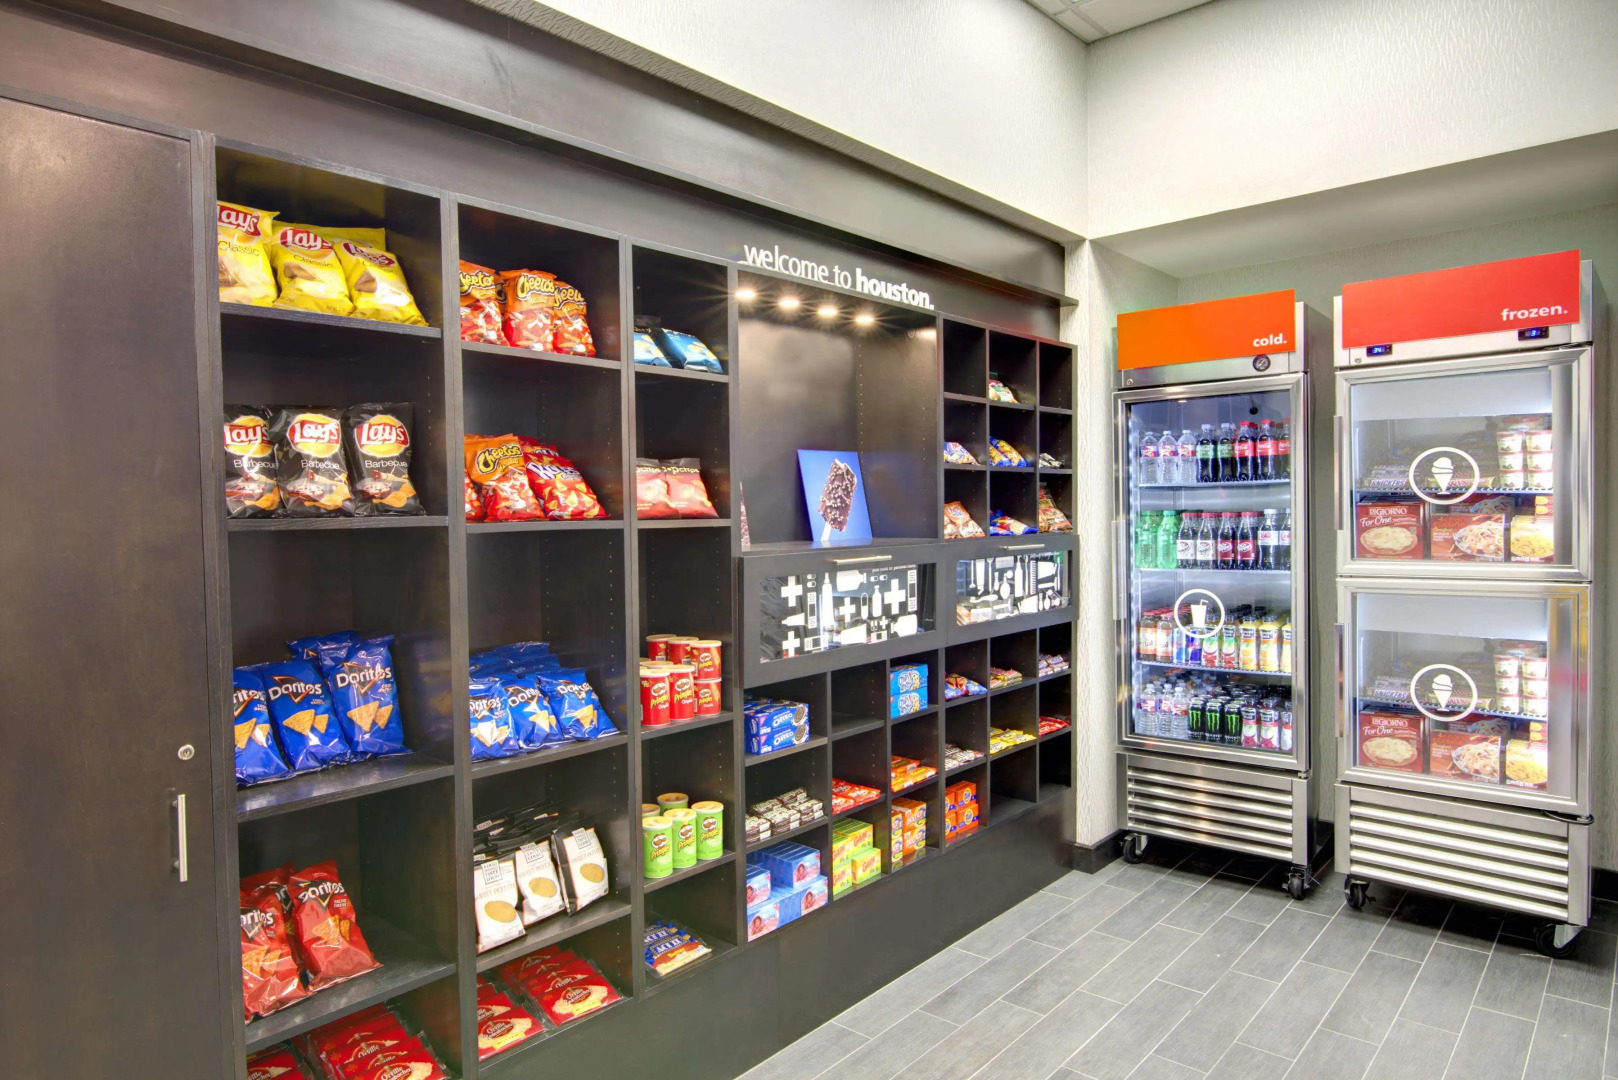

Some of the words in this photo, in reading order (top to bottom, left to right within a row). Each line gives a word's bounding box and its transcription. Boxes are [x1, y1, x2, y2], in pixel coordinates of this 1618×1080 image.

[743, 244, 829, 284] welcome
[832, 265, 852, 289] to
[856, 268, 935, 310] houston.
[1501, 304, 1568, 321] frozen.
[1253, 333, 1288, 347] cold.
[360, 421, 405, 446] Lay's
[365, 459, 408, 469] Barbecue
[477, 445, 522, 474] Cheetos
[336, 667, 392, 689] Doritos
[268, 684, 323, 701] Doritos
